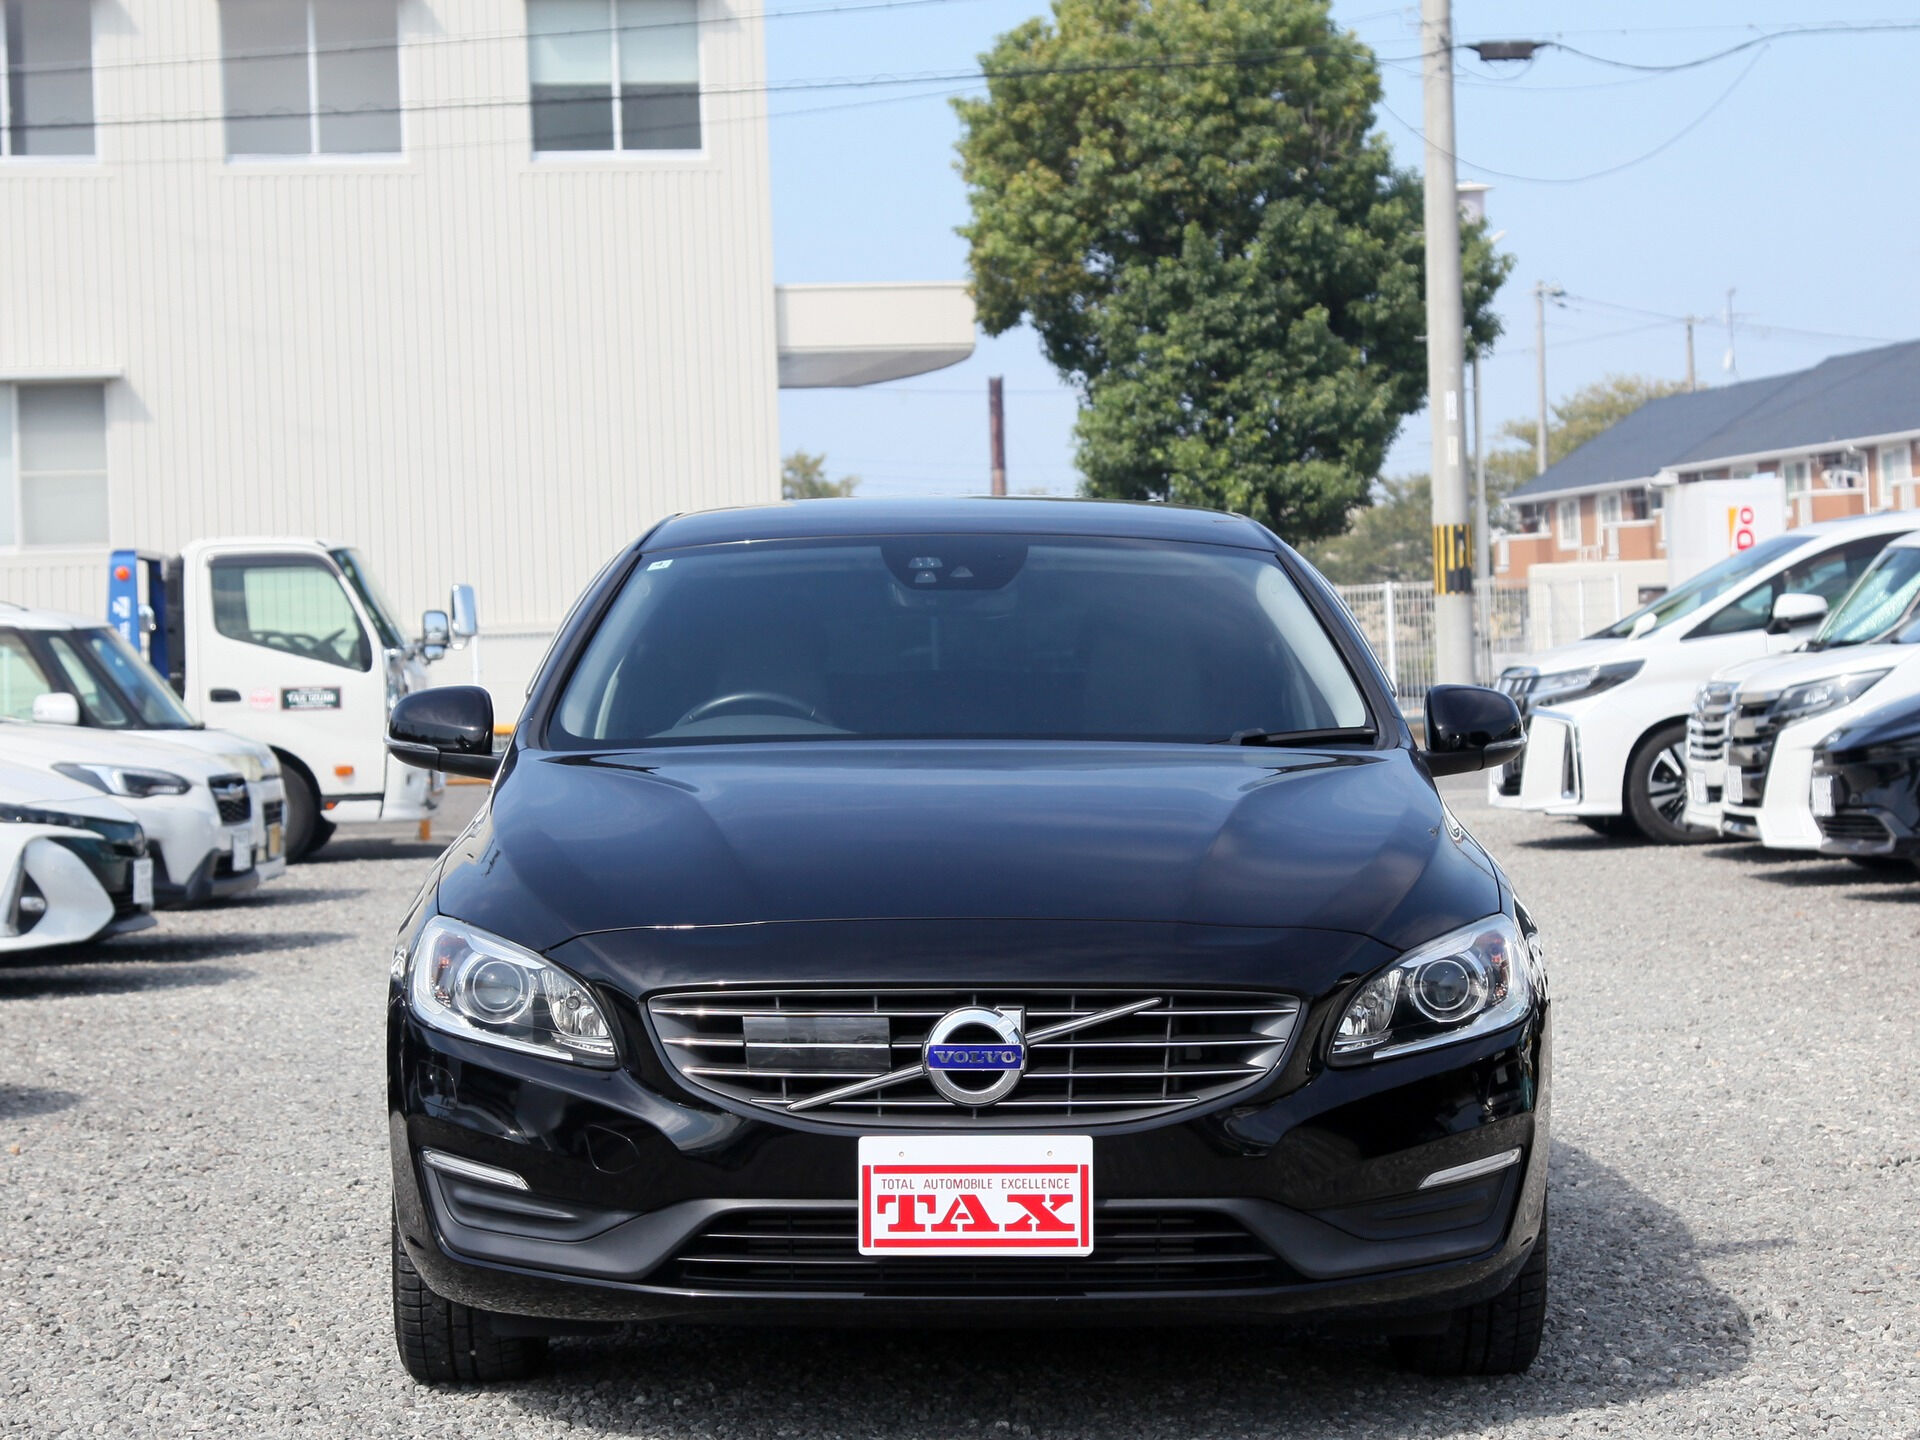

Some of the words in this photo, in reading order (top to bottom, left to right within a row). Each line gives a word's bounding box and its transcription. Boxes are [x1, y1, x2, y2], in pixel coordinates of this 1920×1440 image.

[934, 1050, 1017, 1064] VOLVO
[881, 1178, 915, 1190] TOTAL
[923, 1178, 993, 1190] AUTOMOBILE
[1001, 1178, 1070, 1190] EXCELLENCE
[877, 1194, 1075, 1232] TAX
